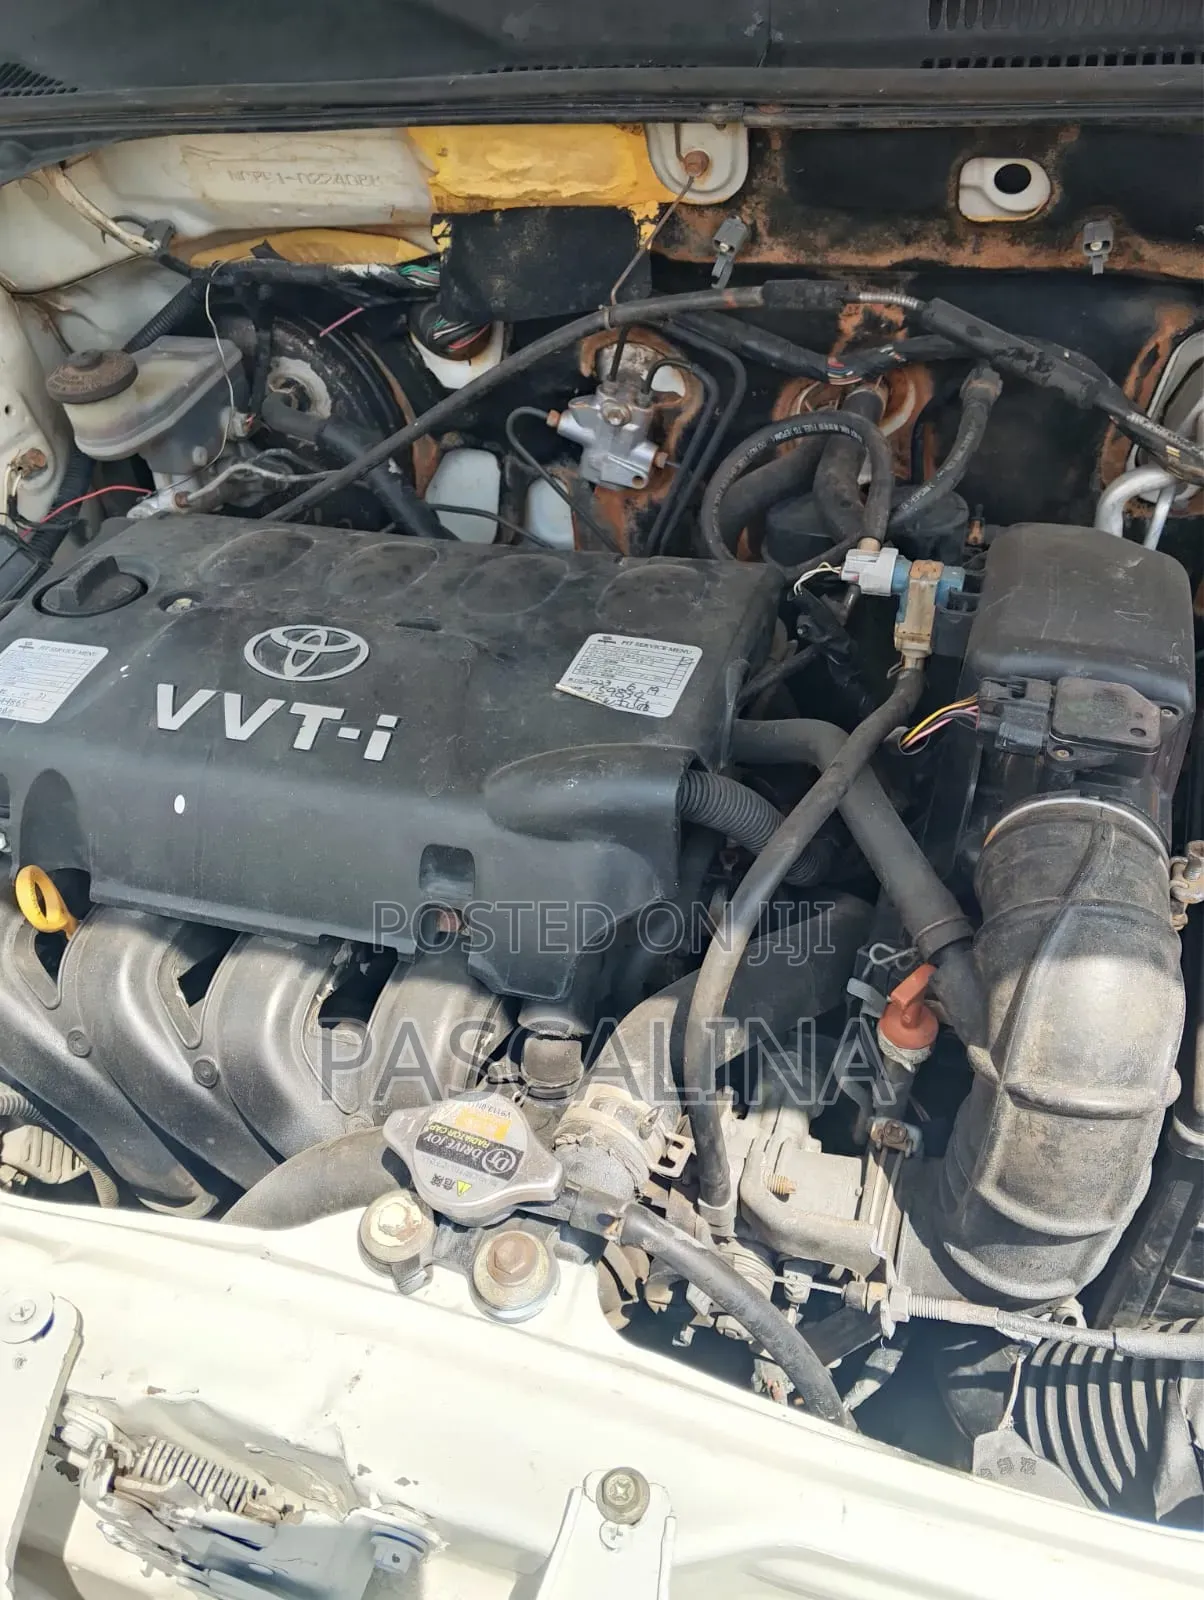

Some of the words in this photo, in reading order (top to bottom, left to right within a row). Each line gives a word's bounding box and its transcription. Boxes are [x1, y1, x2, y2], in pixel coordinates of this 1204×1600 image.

[668, 647, 693, 655] MENU
[157, 682, 399, 762] VVT-i
[429, 1122, 451, 1138] CAP
[423, 1132, 447, 1149] JOY
[445, 1137, 484, 1160] DRIVE
